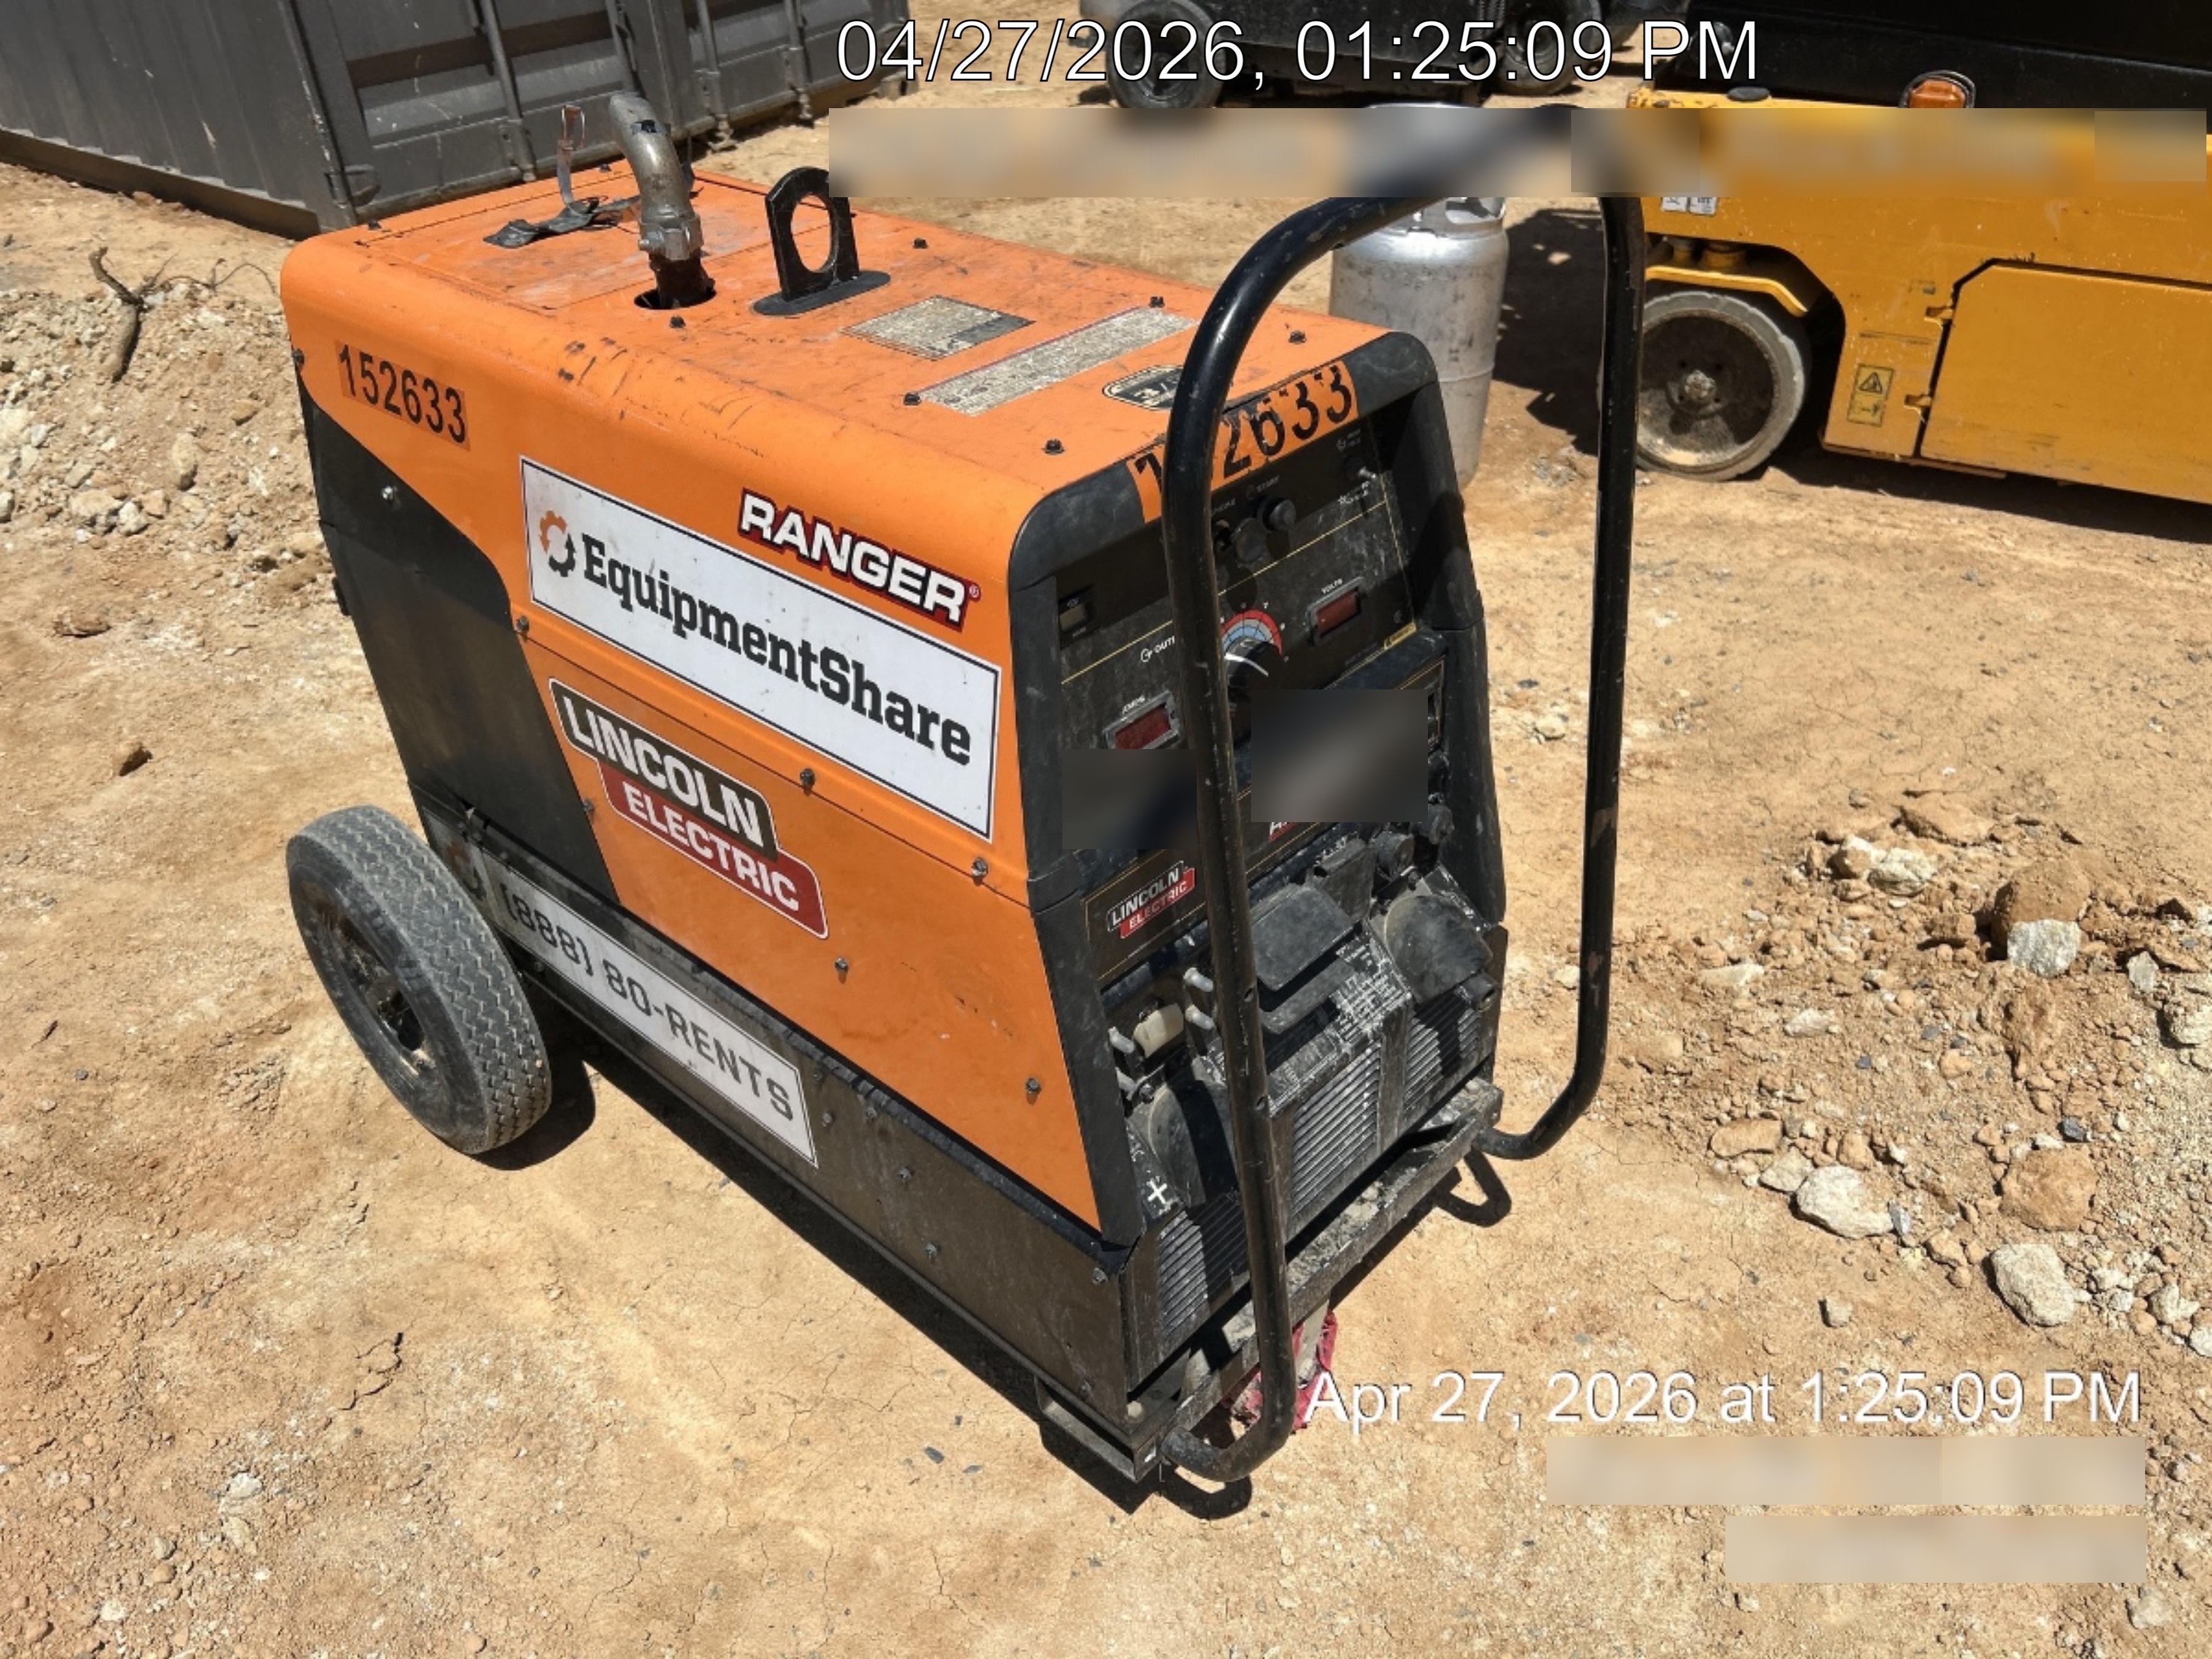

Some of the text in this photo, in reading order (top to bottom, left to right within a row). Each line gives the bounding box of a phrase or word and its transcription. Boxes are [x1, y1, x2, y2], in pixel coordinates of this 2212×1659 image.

[340, 344, 467, 444] 152633
[1135, 365, 1352, 490] 12633
[582, 533, 971, 766] EquipmentShare
[563, 696, 765, 846] LINCOLN
[622, 782, 799, 912] ELECTRIC
[1112, 867, 1180, 926] LINCOLN
[1129, 880, 1187, 930] ELECTRIC
[498, 883, 794, 1121] (888) 80-RENTS
